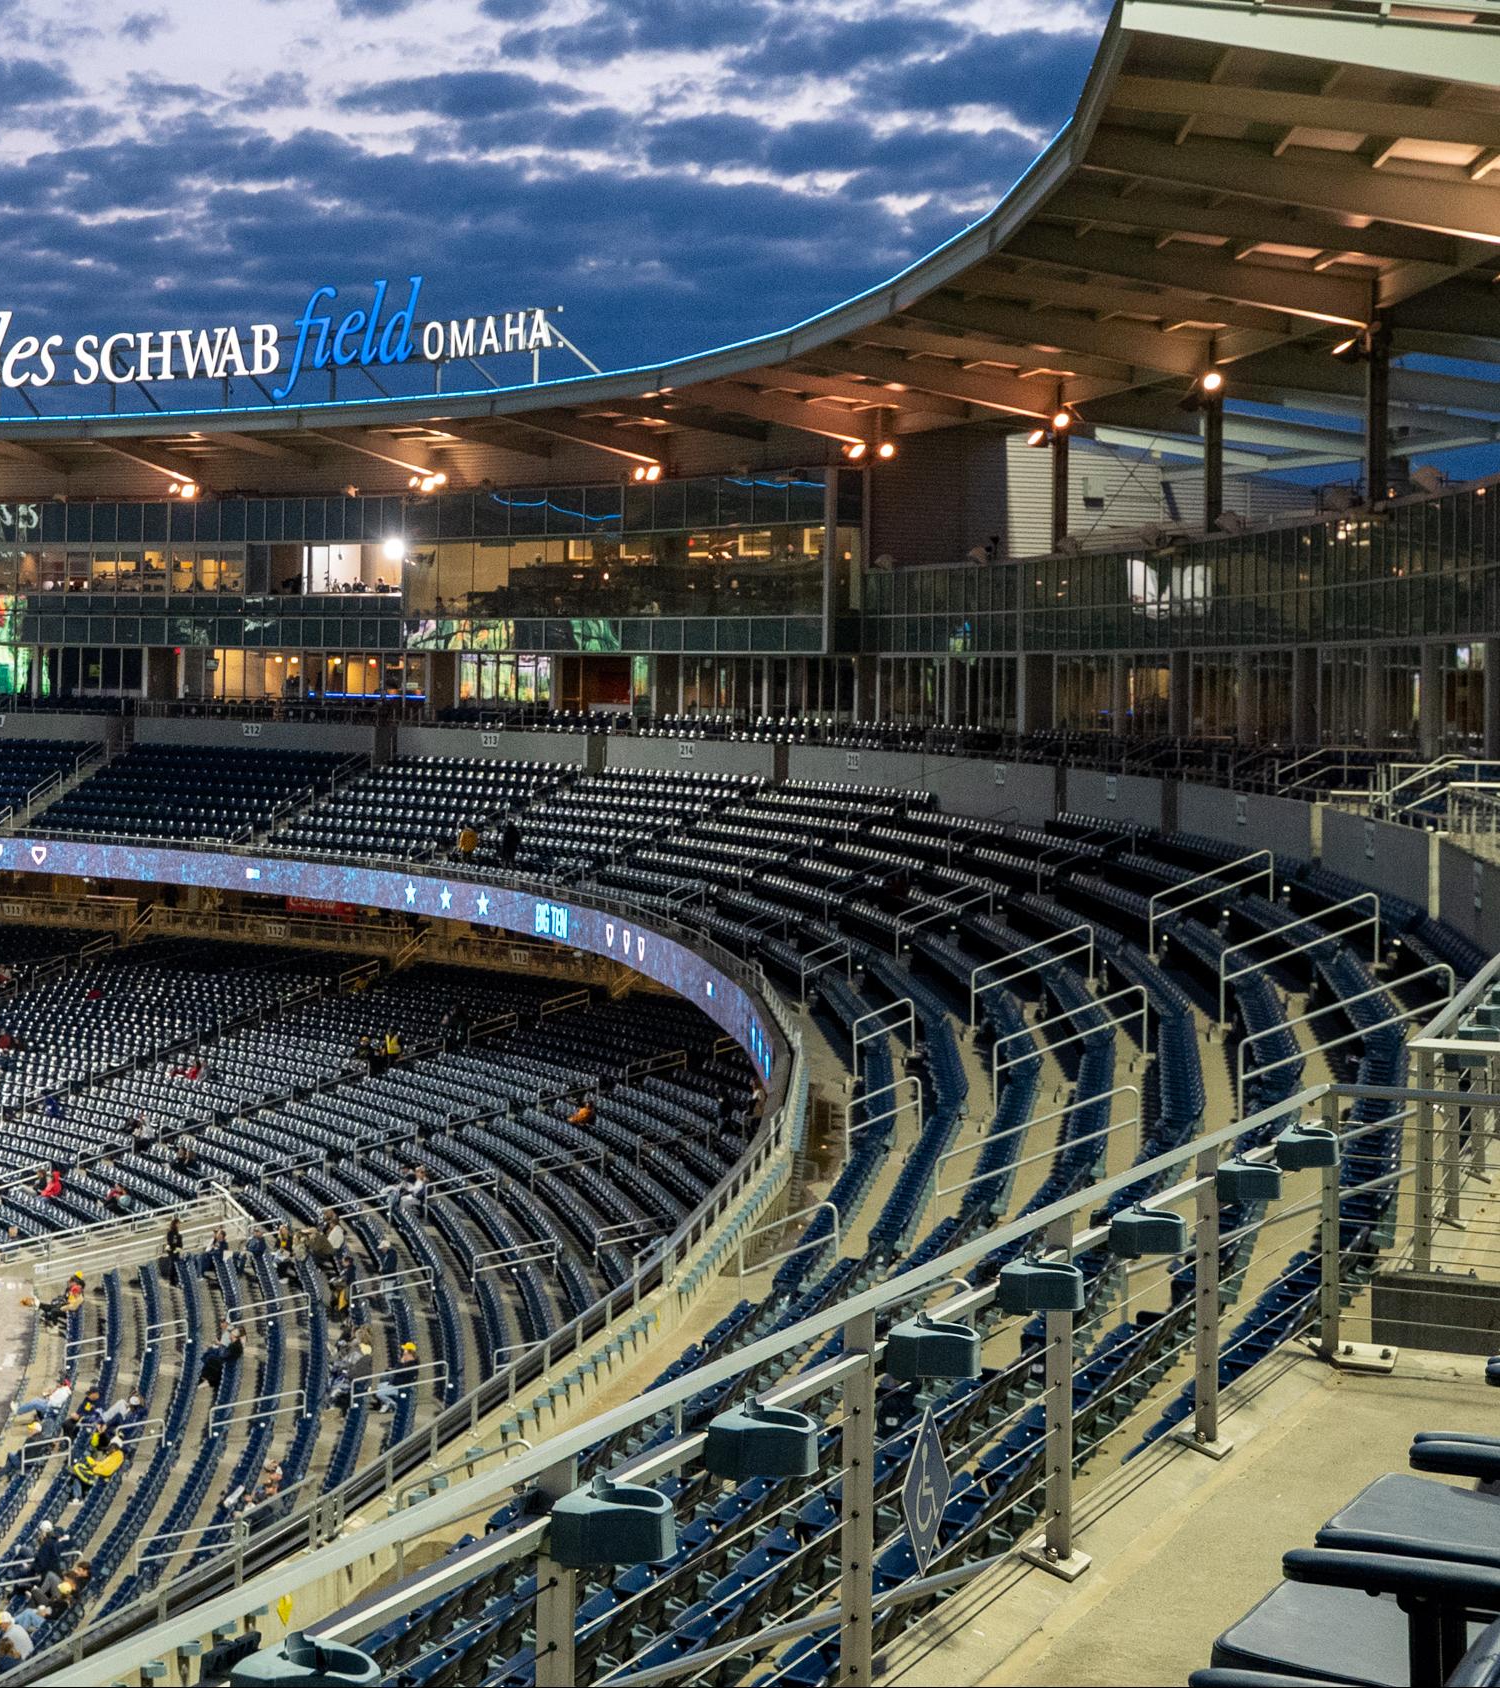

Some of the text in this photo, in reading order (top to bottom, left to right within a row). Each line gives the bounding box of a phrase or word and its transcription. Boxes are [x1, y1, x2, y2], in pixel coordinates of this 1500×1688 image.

[74, 324, 281, 386] SCHWAB
[272, 275, 423, 400] field
[423, 309, 552, 360] OMAHA
[244, 726, 260, 734] 212
[483, 735, 498, 745] 213
[680, 745, 693, 755] 214
[6, 905, 20, 914] 111
[535, 903, 568, 939] BIG TEN
[268, 926, 283, 935] 112
